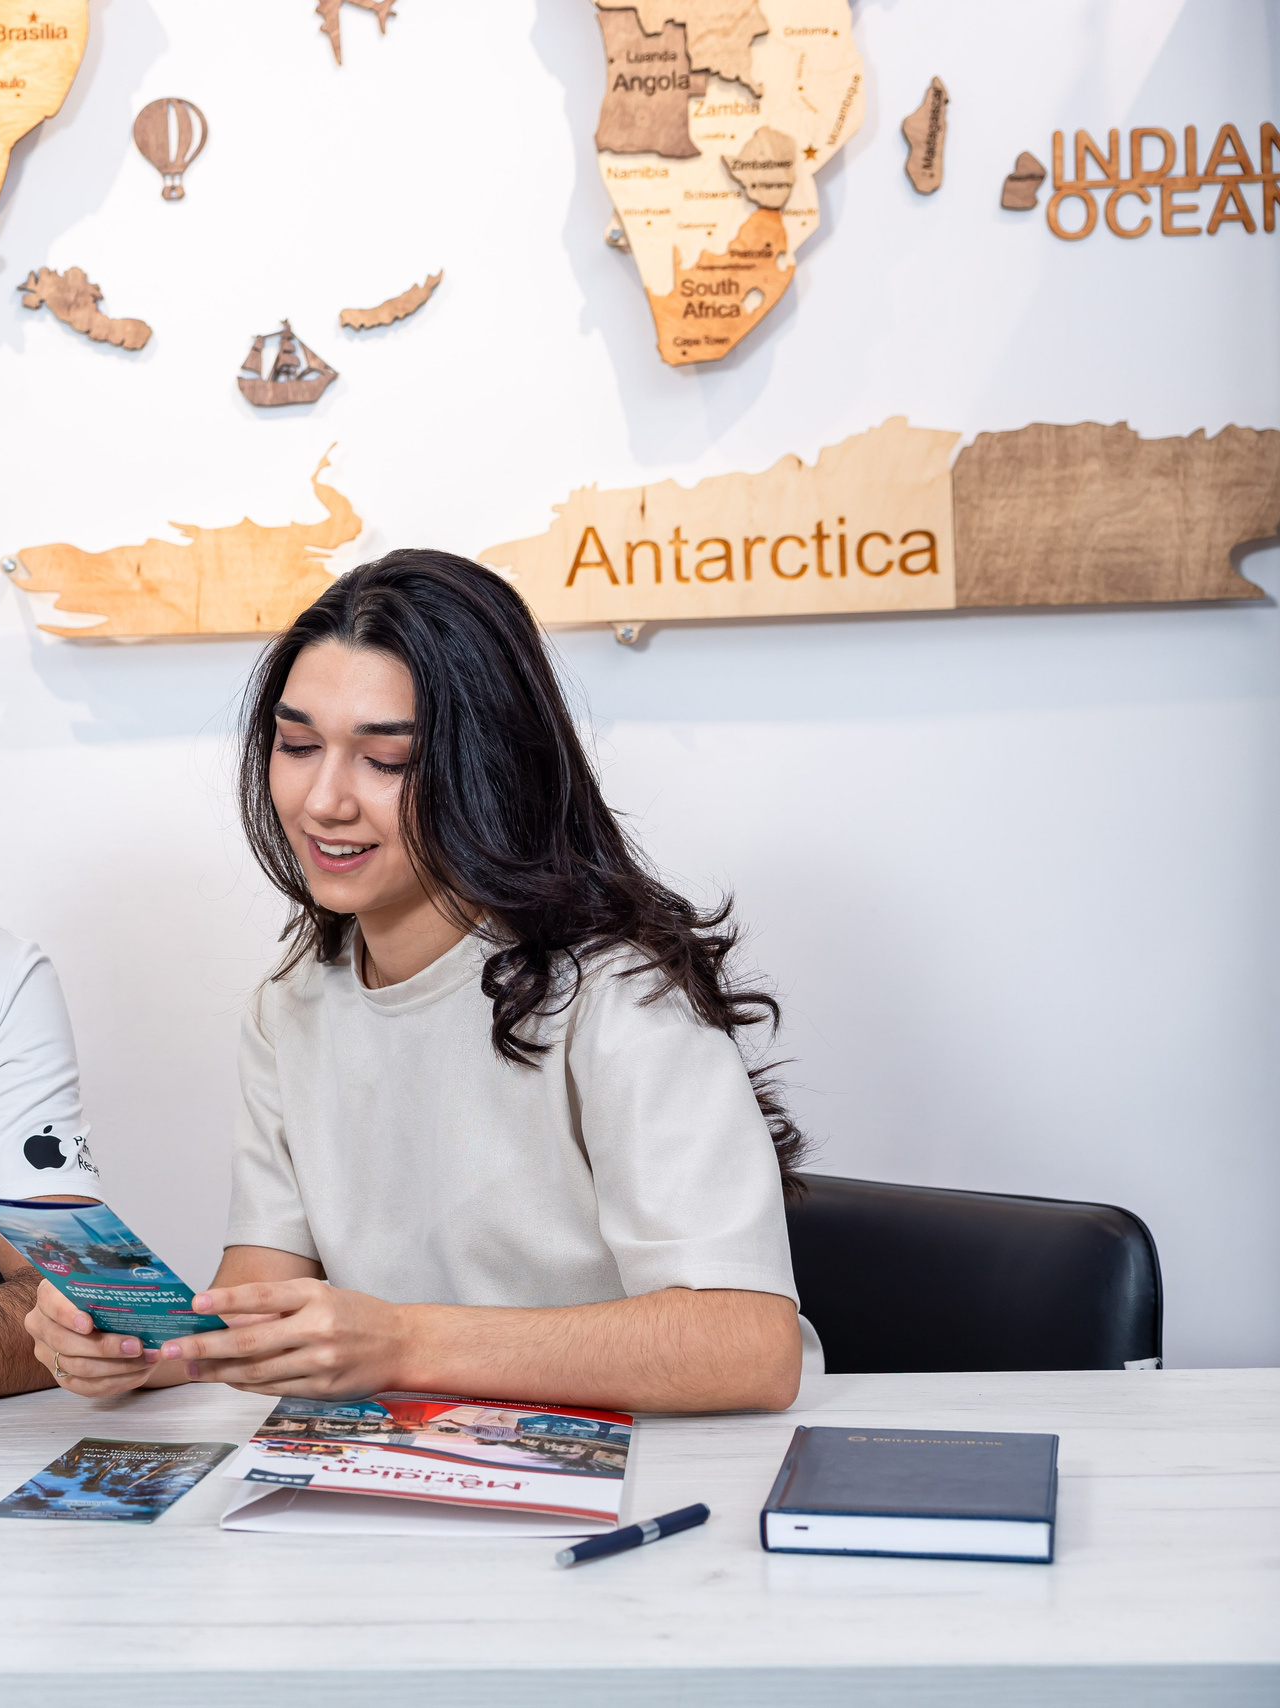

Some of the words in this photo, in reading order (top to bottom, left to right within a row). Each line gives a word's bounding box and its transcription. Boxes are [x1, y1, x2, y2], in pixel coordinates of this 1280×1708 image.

[626, 50, 678, 63] Luanda
[613, 71, 690, 95] Angola
[693, 100, 761, 117] Zambia
[731, 158, 794, 172] Zimbabwe
[607, 166, 669, 180] Namibia
[681, 279, 739, 297] South
[683, 301, 740, 319] Africa
[702, 335, 730, 346] Town
[565, 516, 939, 588] Antarctica
[71, 1291, 114, 1301] НОВАЯ
[114, 1295, 187, 1304] ГЕОГРАФИЯ
[321, 1465, 524, 1491] Meridian
[430, 1470, 480, 1479] World
